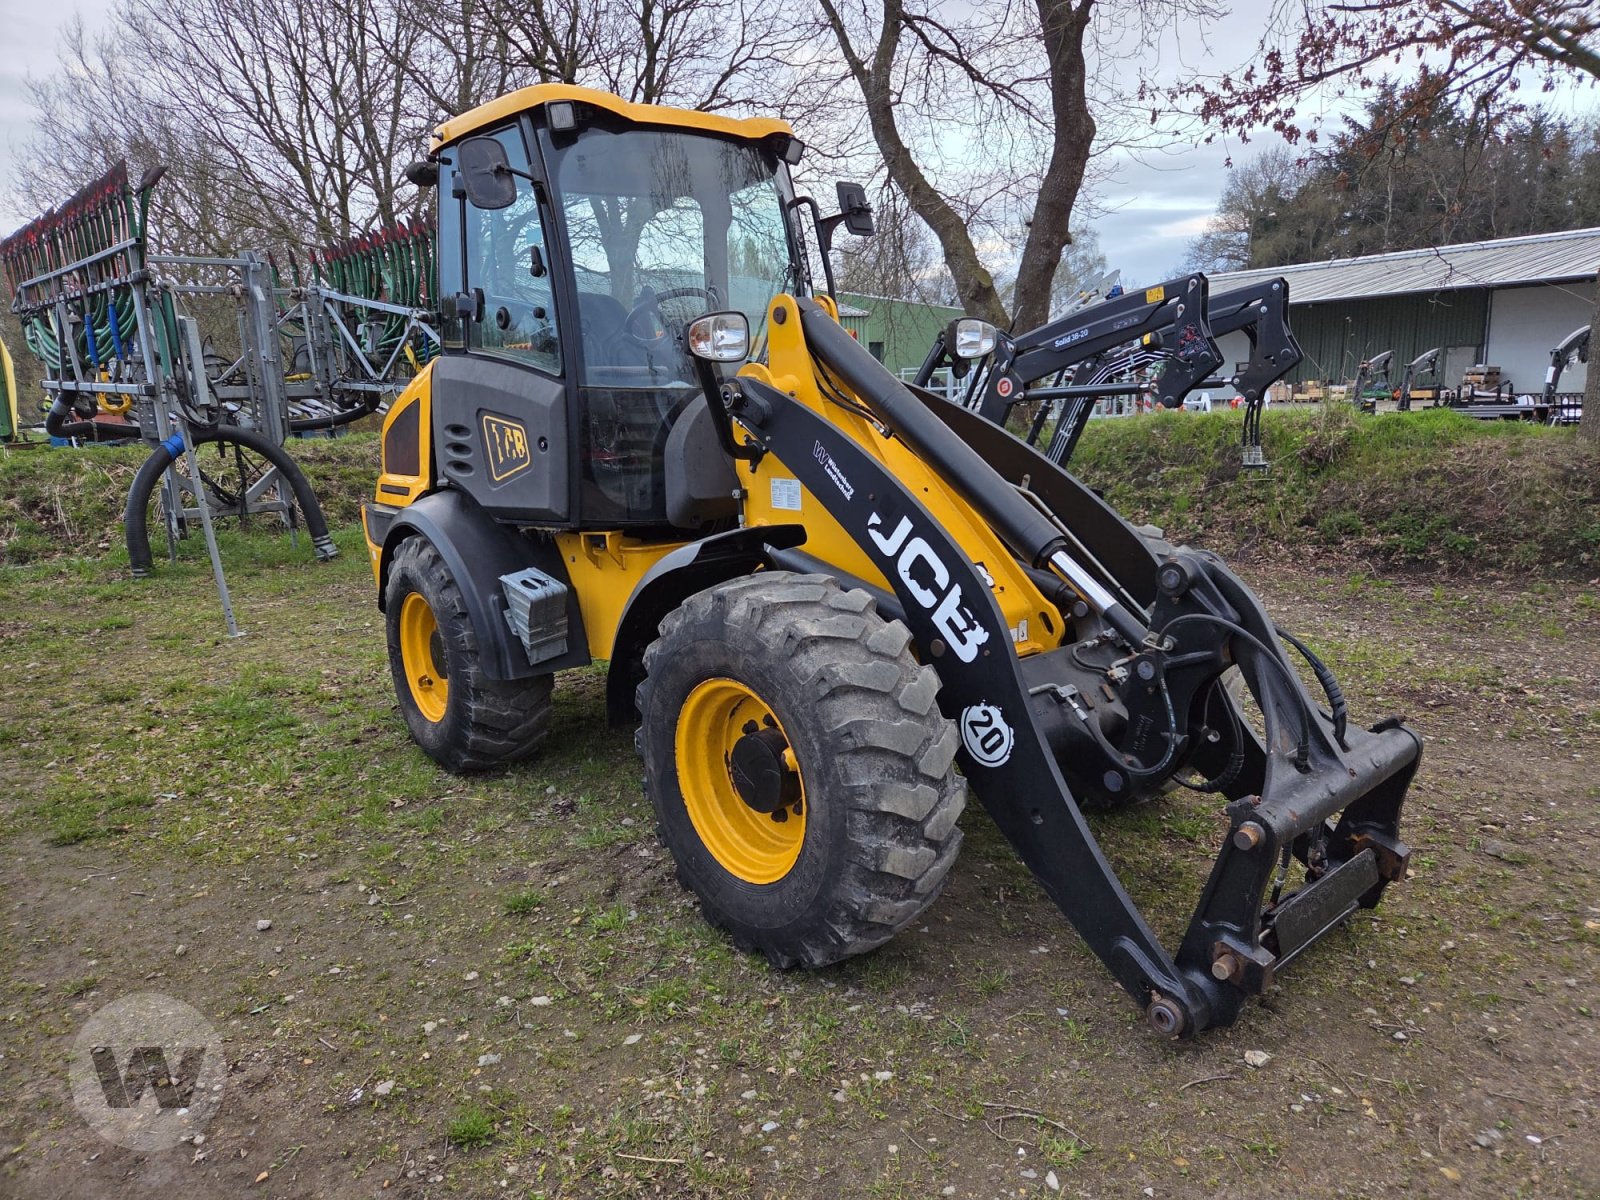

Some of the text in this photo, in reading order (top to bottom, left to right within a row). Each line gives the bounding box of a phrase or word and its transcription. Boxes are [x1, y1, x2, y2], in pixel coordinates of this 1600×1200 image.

[1054, 335, 1071, 348] Solid
[491, 423, 526, 465] JCB
[867, 511, 990, 664] JCB
[967, 709, 1005, 757] 20
